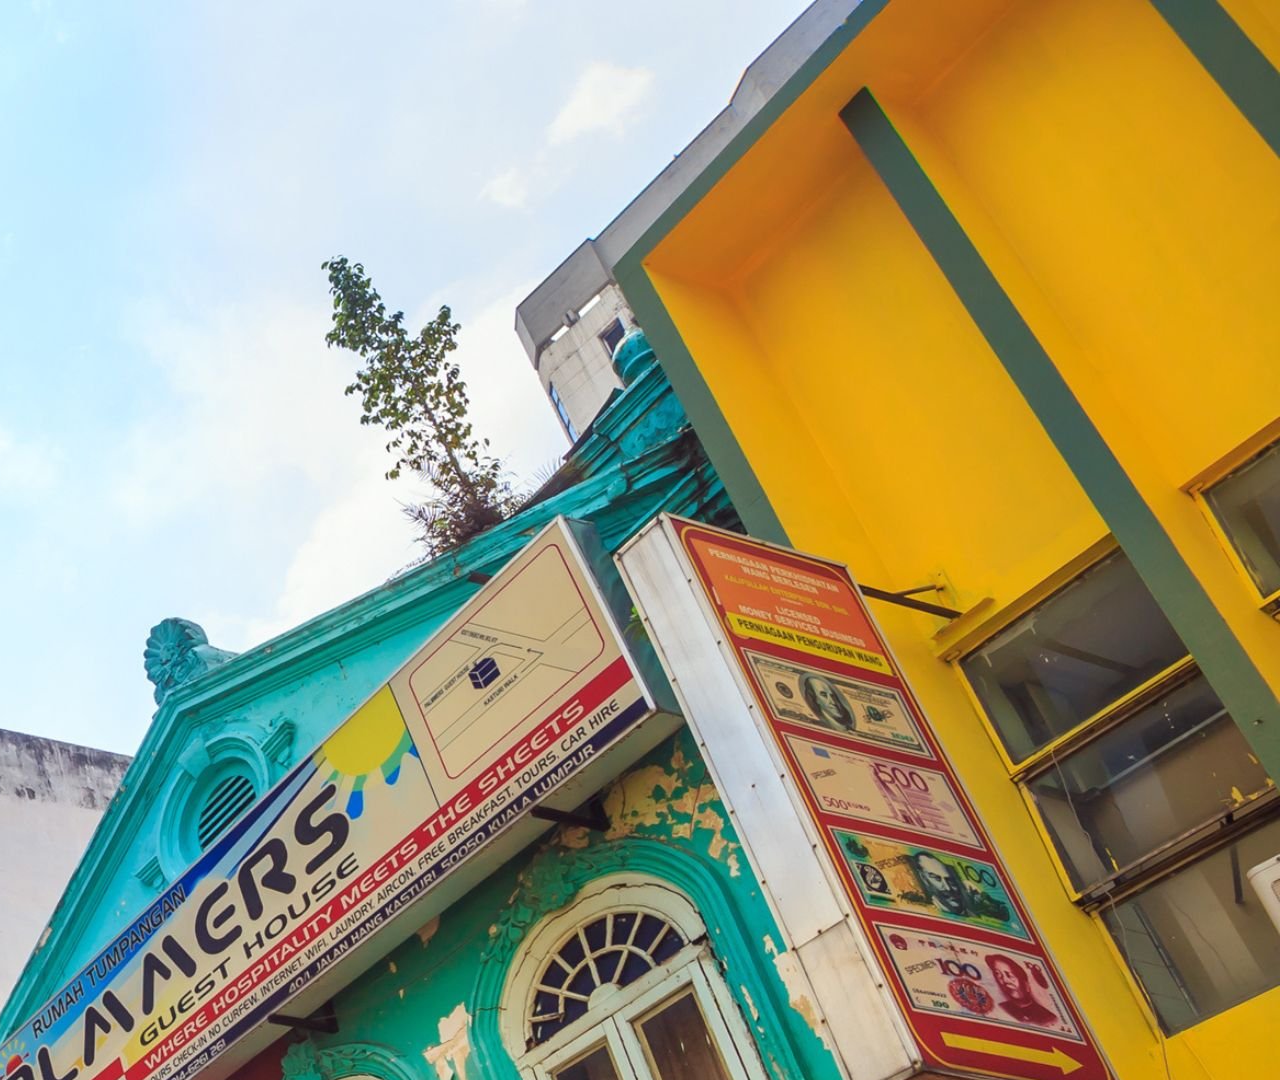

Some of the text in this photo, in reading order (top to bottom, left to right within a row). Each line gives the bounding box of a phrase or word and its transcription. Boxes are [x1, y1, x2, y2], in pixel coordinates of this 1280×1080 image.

[741, 566, 770, 581] WANG
[738, 604, 772, 620] MONEY
[775, 613, 821, 635] SERVICES
[776, 606, 821, 625] LICENSED
[737, 618, 883, 667] PERNIAGAAN PENGURUPAN WANG
[873, 762, 929, 793] 500
[822, 796, 848, 811] 500
[315, 940, 351, 976] JALAN
[350, 913, 384, 943] HANG
[441, 831, 487, 871] 50050
[487, 795, 532, 838] KUALA
[533, 743, 596, 797] LUMPUR
[957, 861, 997, 888] 100
[144, 699, 586, 1070] WHERE HOSPITALITY MEETS THE SHEETS
[172, 1033, 209, 1070] CHECK-IN
[208, 1024, 222, 1038] NO
[418, 843, 446, 871] FREE
[560, 725, 587, 753] CAR
[588, 698, 620, 731] HIRE
[32, 884, 186, 1039] RUMAH TUMPANGAN
[140, 851, 360, 1047] GUEST HOUSE
[935, 958, 982, 981] 100
